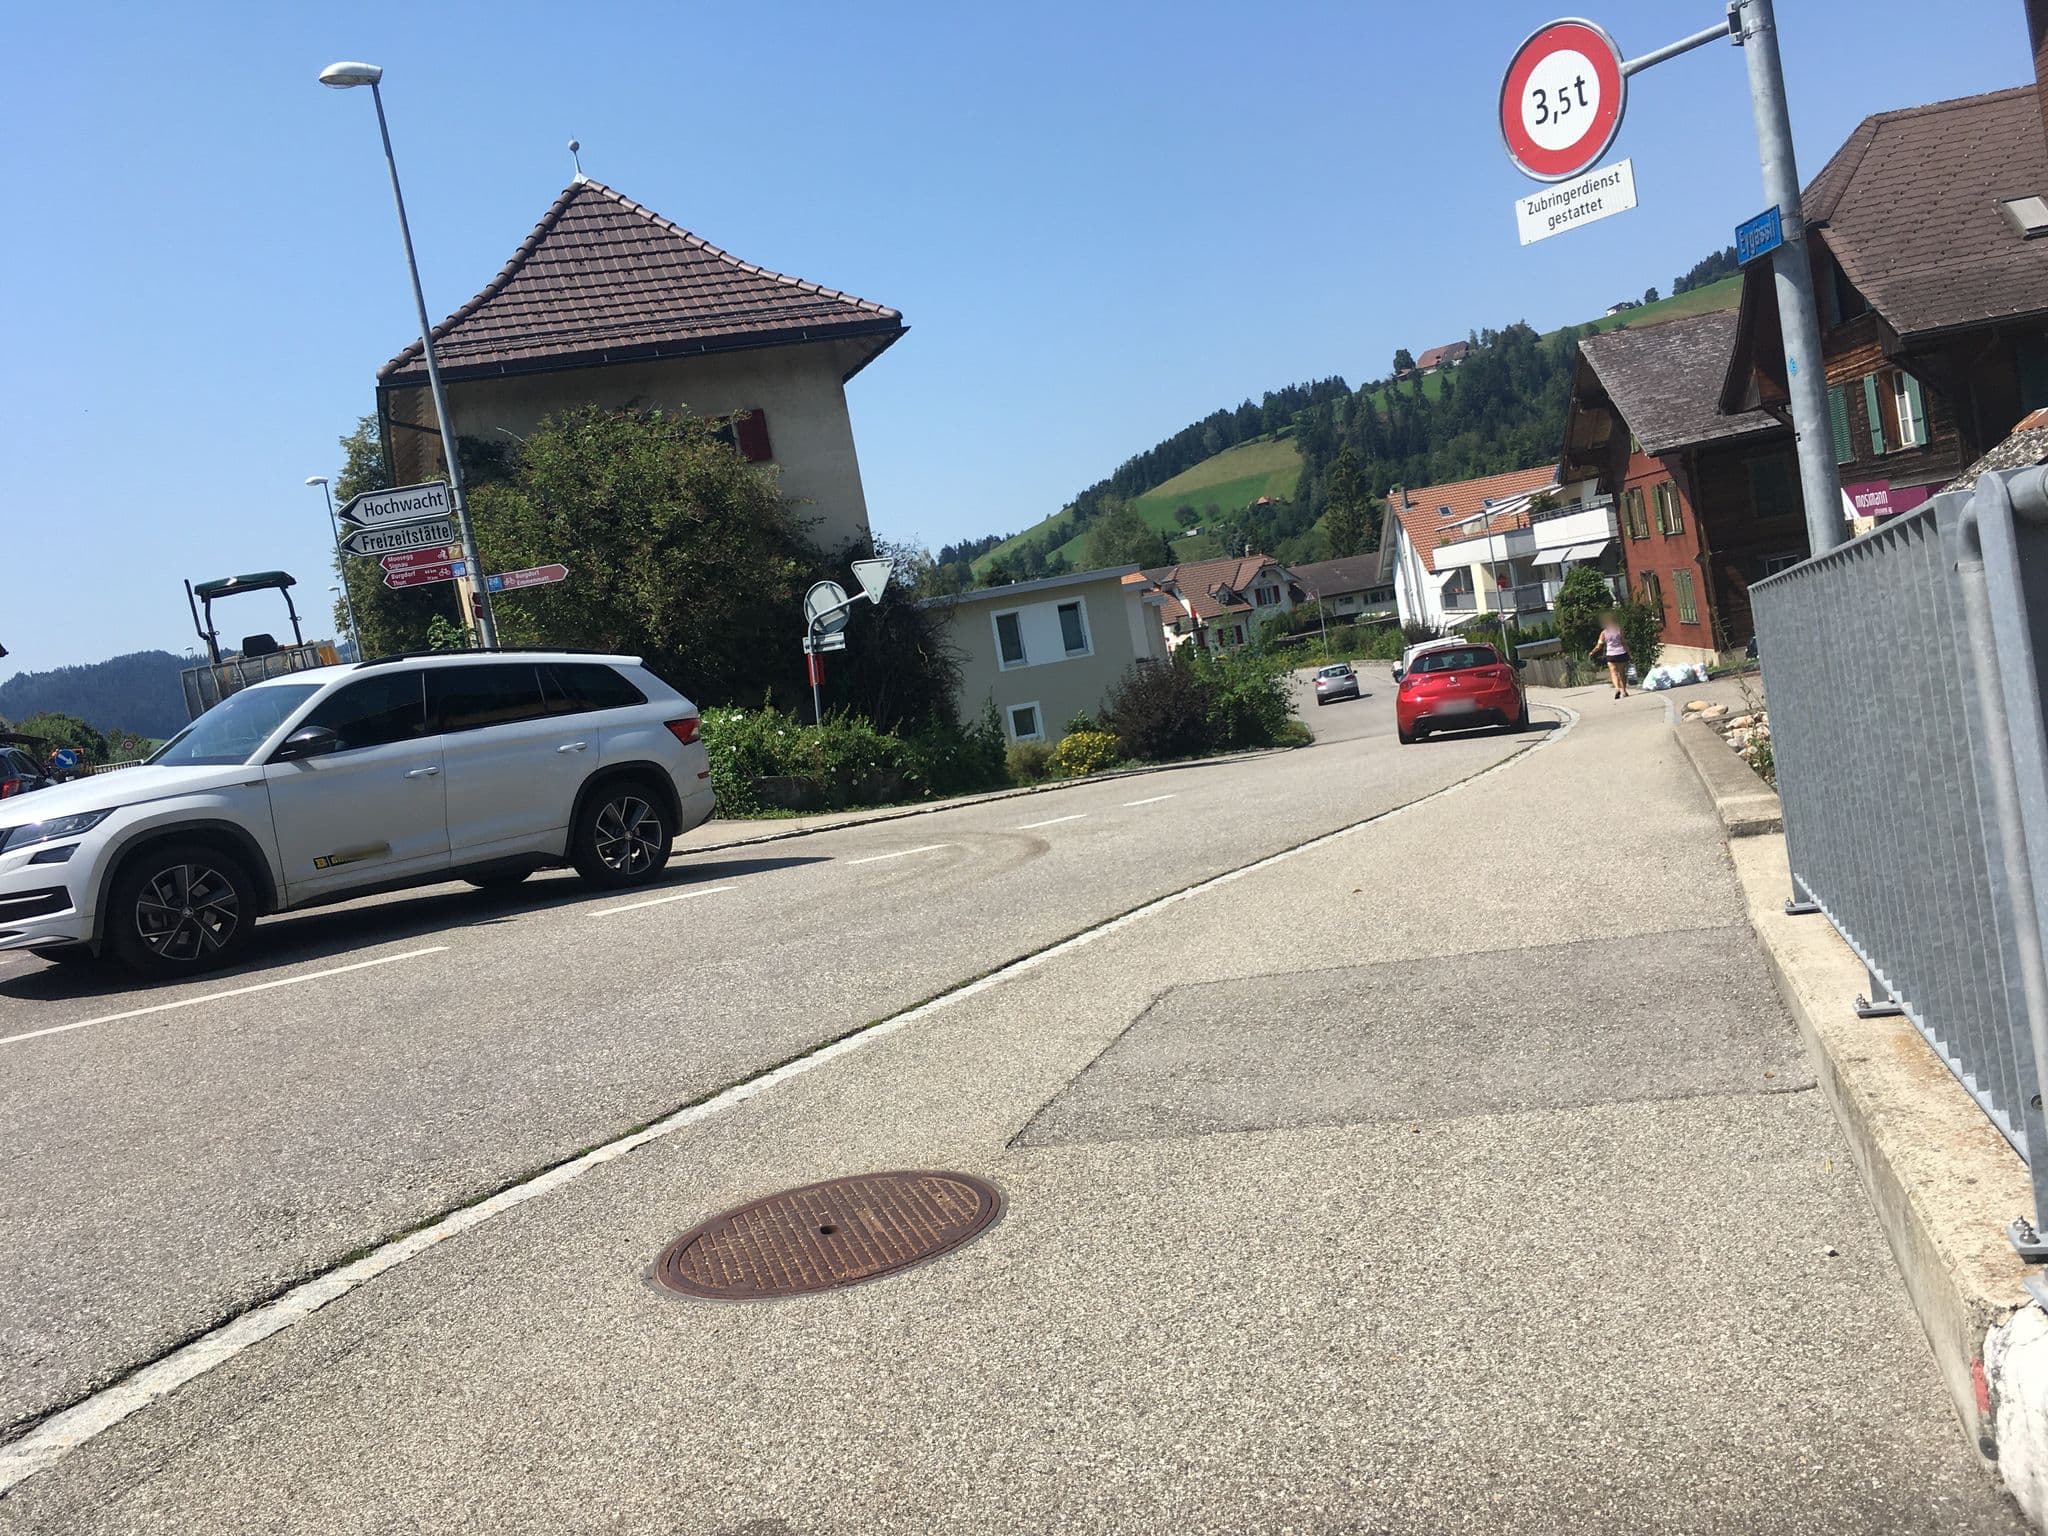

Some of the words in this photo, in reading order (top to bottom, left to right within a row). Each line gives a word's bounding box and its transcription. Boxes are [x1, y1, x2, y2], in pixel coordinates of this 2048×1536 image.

[1527, 171, 1621, 216] Zubringerdienst
[1547, 197, 1604, 230] gestattet
[364, 491, 444, 518] Hochwacht
[362, 524, 449, 552] Freizeitstätte
[391, 570, 416, 580] Burgdorf
